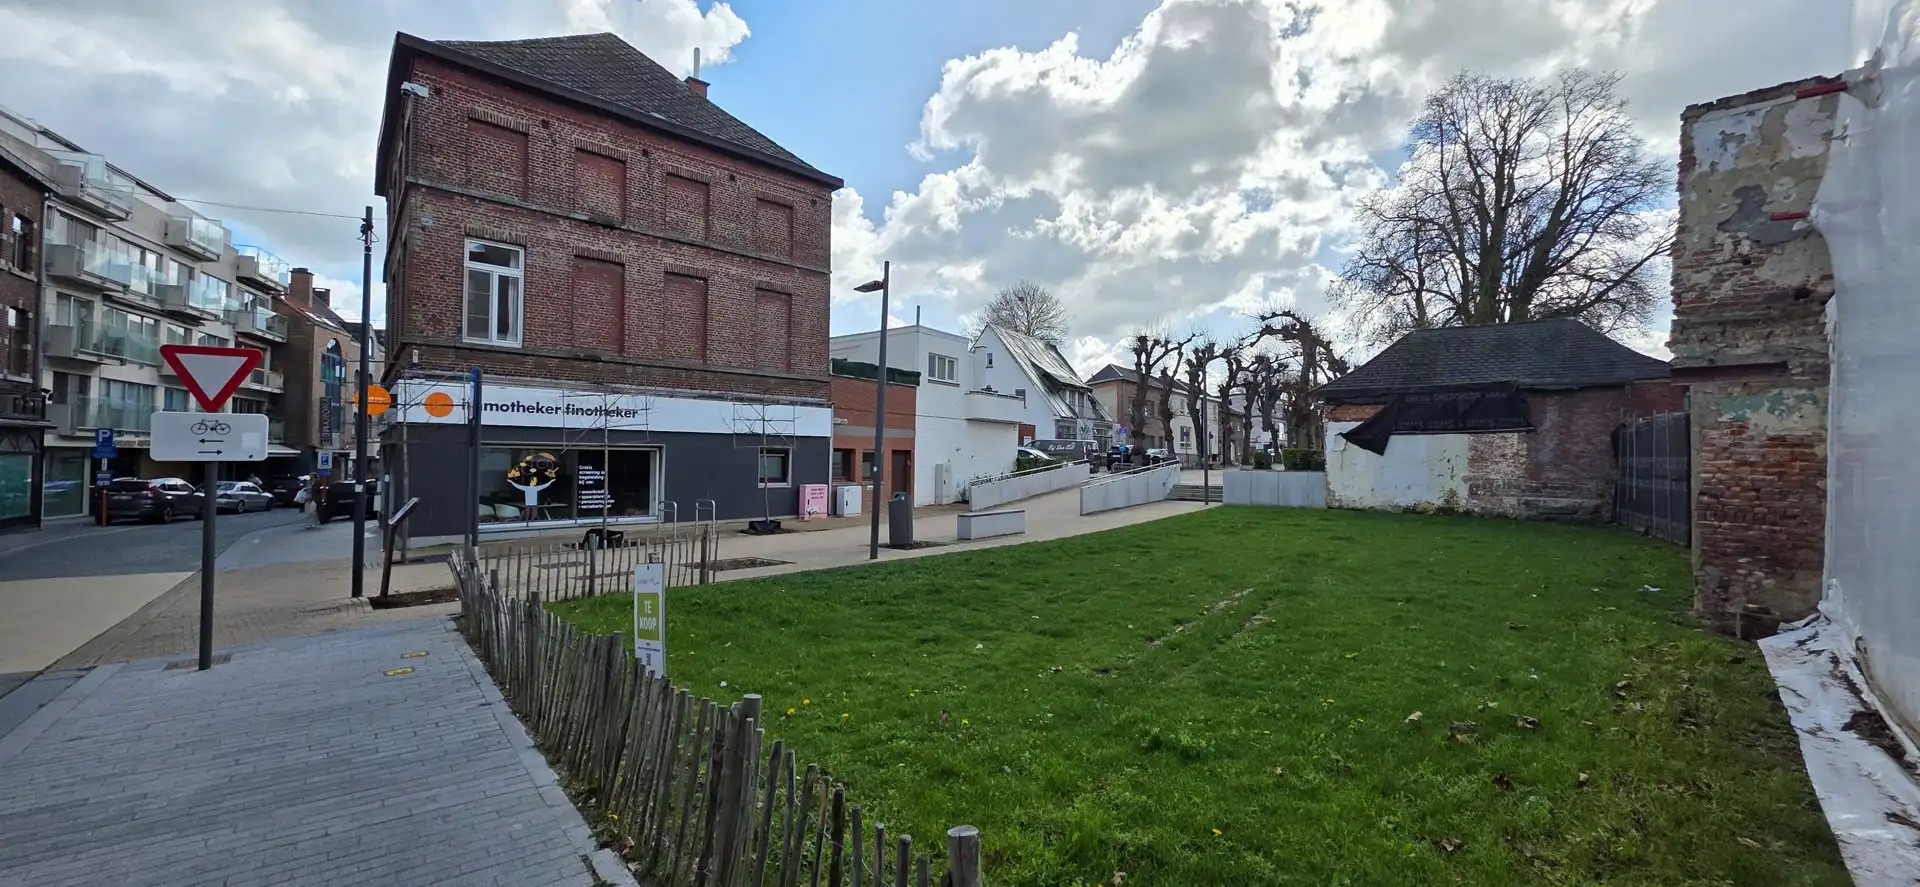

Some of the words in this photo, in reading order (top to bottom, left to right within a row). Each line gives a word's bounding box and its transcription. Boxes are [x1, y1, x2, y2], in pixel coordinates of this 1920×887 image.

[462, 398, 562, 415] imotheker
[565, 403, 638, 419] finotheker
[98, 430, 111, 442] P
[644, 600, 652, 614] TE
[640, 617, 656, 631] KOOP
